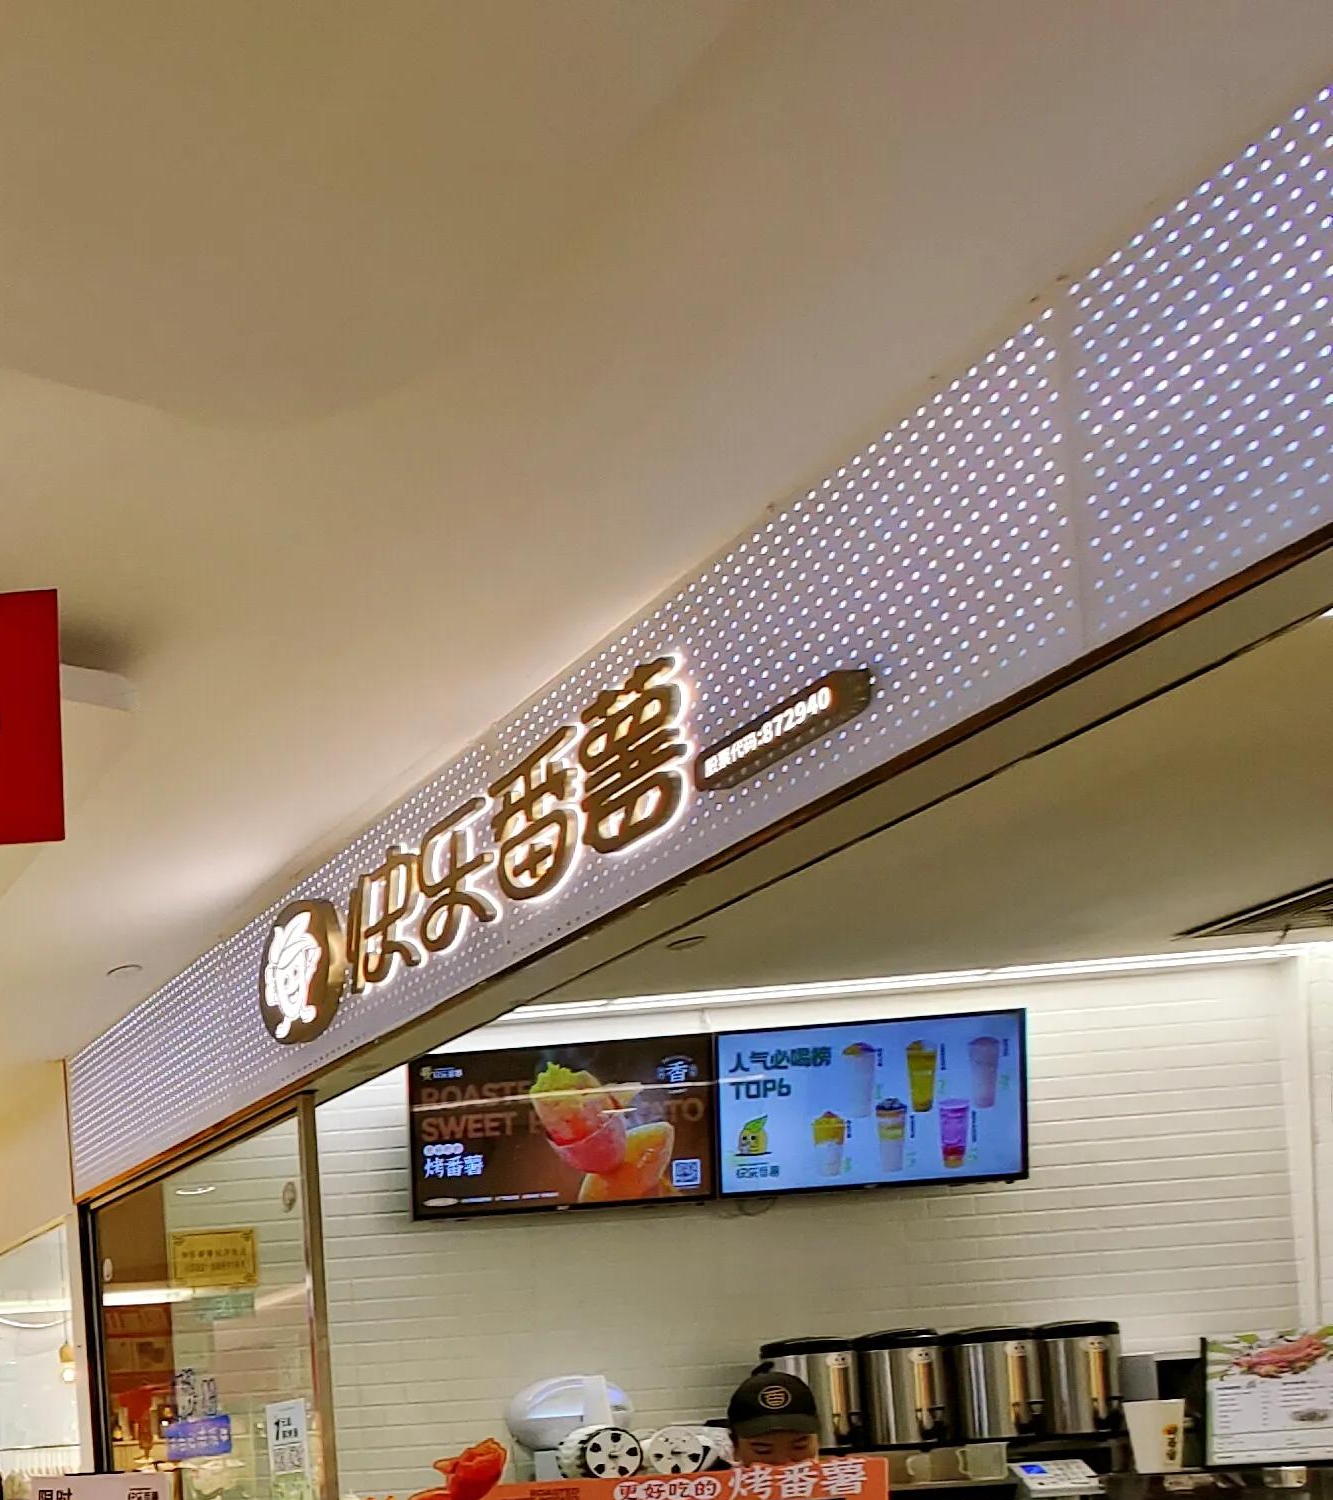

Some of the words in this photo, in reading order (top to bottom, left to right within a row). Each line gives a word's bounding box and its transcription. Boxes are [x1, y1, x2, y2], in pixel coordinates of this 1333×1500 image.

[347, 653, 691, 994] 快乐番薯
[421, 1080, 532, 1105] ROASTE
[730, 1076, 792, 1100] TOP6
[424, 1154, 485, 1179] 烤番薯
